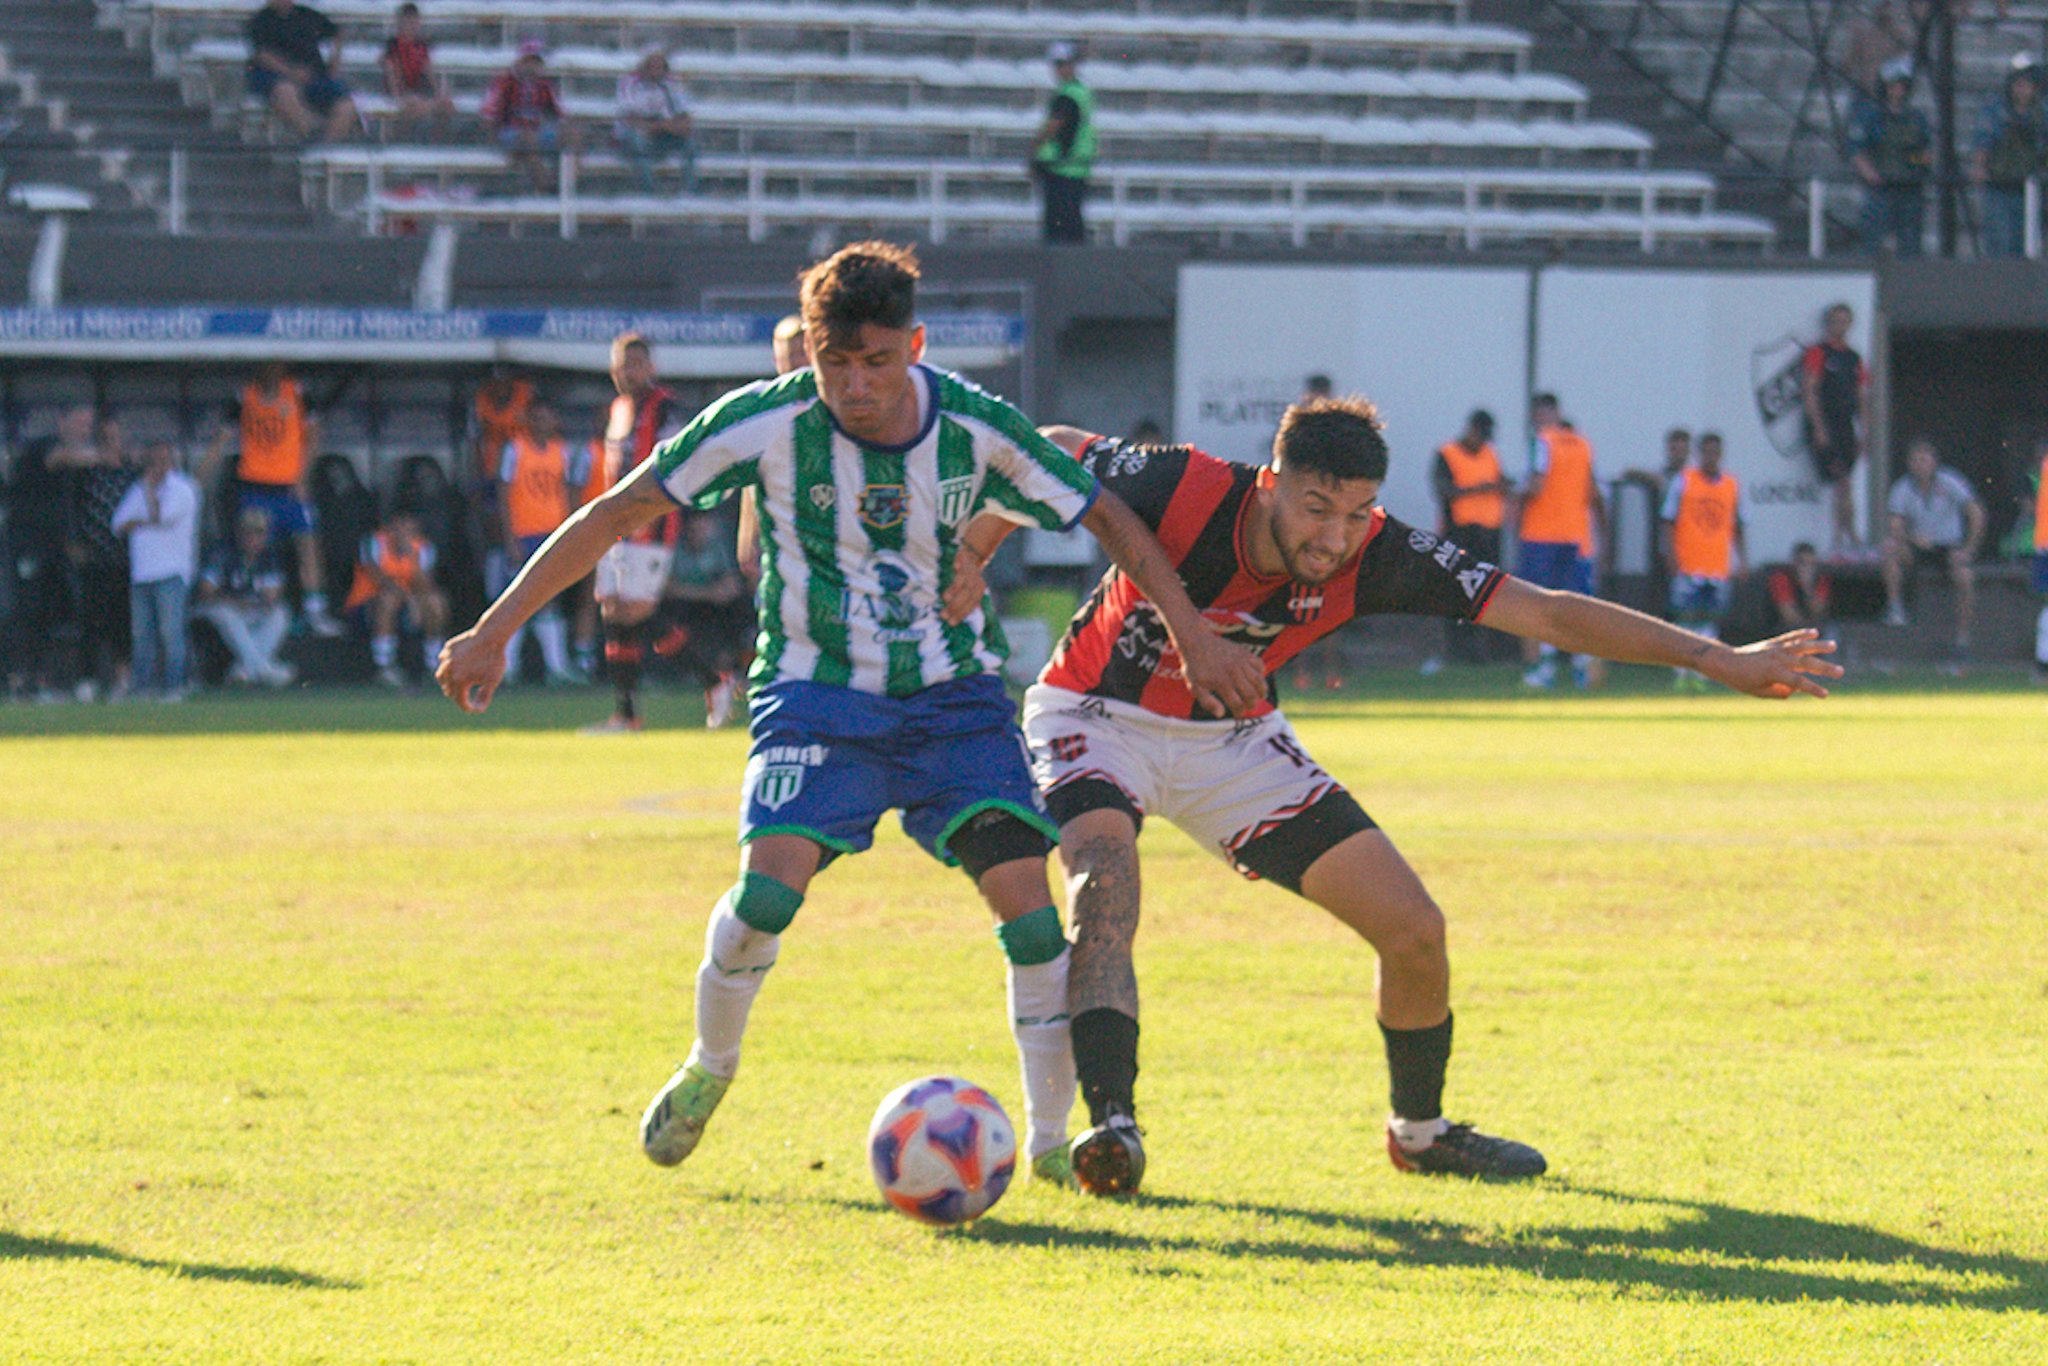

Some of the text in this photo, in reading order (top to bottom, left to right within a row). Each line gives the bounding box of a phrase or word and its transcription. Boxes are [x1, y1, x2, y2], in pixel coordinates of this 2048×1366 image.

[83, 308, 204, 338] Mercado
[361, 309, 479, 339] Mercado
[632, 310, 746, 342] Mercado
